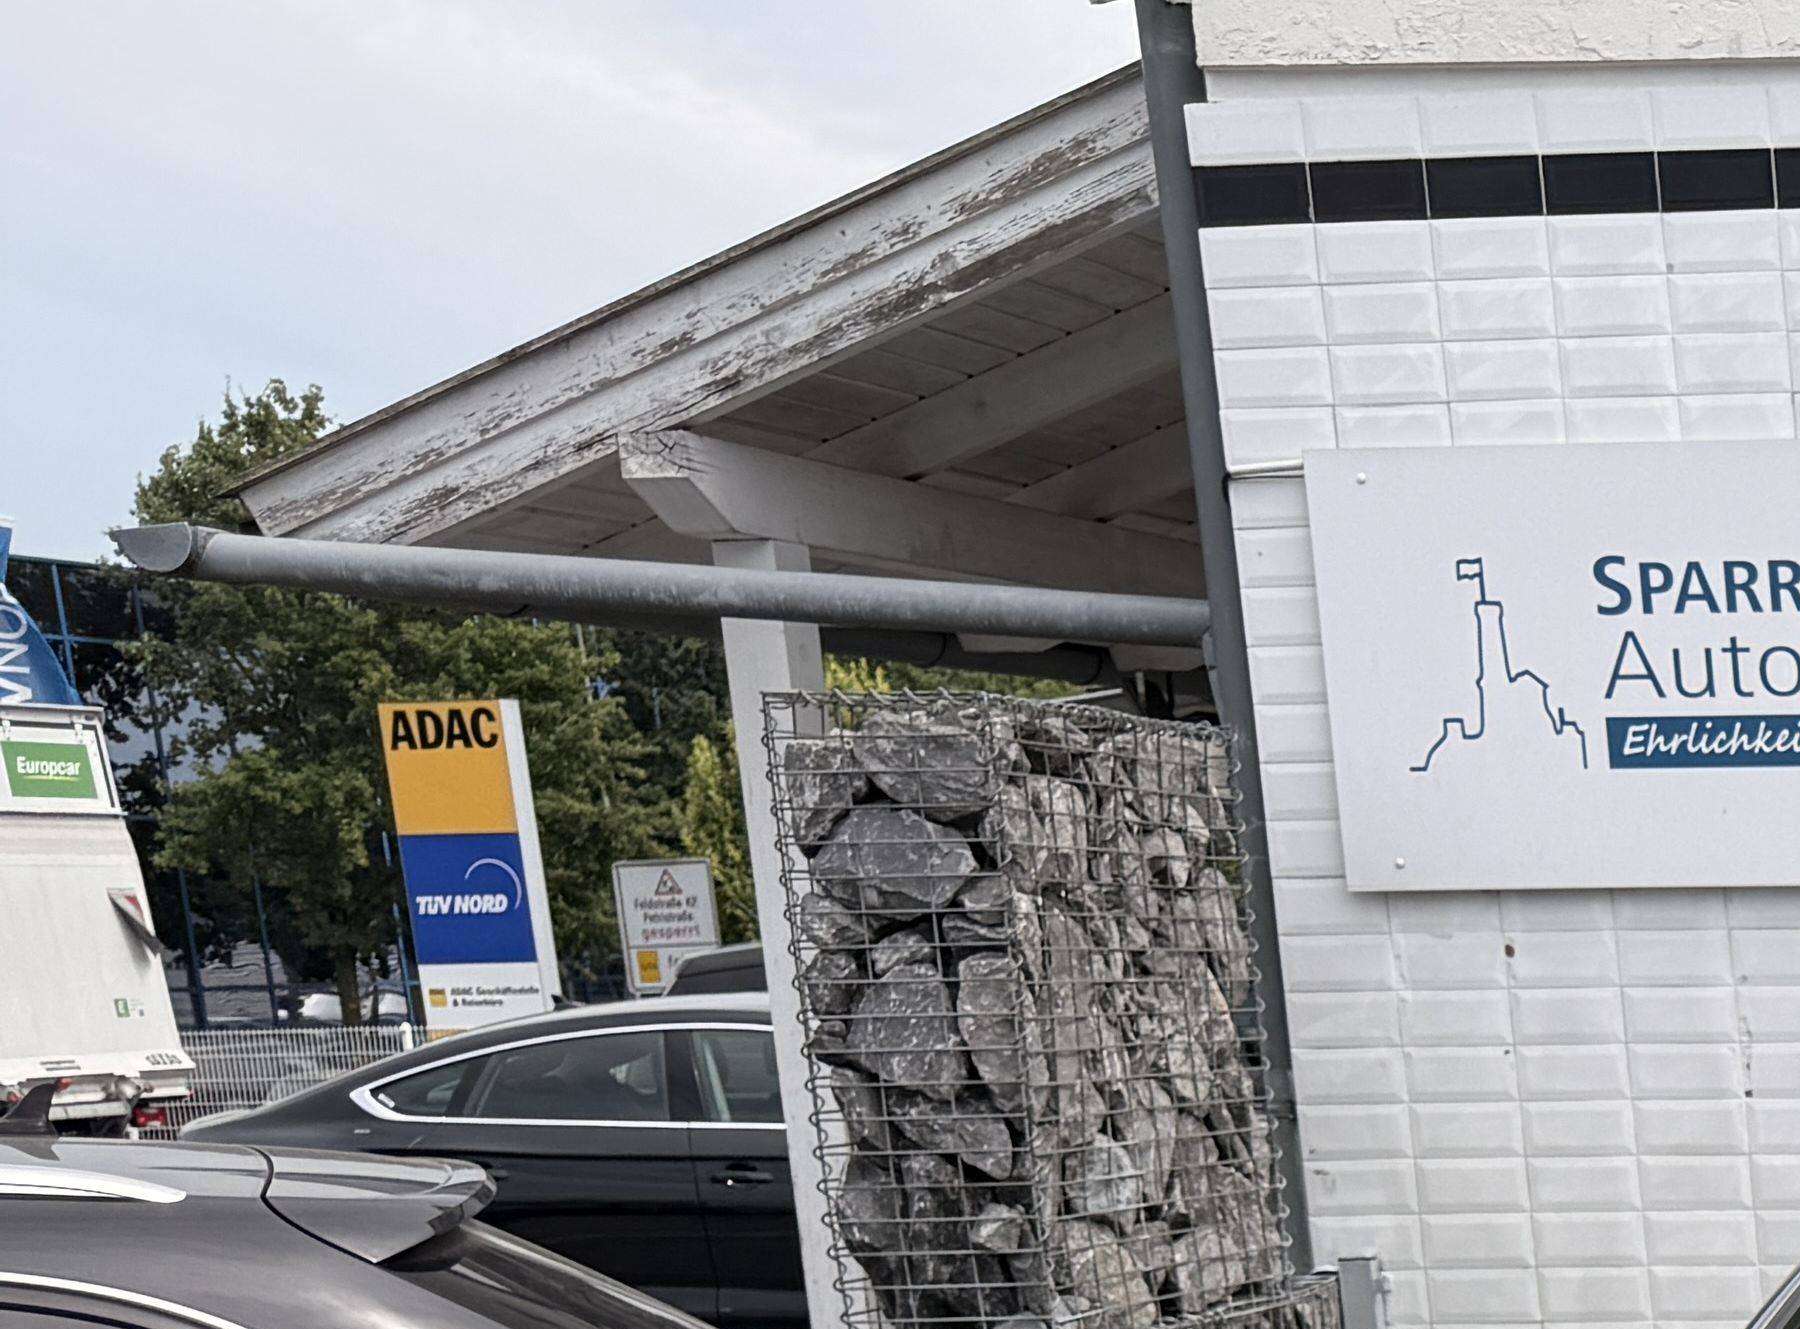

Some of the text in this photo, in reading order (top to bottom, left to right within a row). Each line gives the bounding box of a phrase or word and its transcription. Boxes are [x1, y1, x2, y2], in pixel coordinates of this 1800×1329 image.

[390, 707, 498, 751] ADAC
[16, 756, 81, 777] Europcar
[454, 894, 508, 914] NORD
